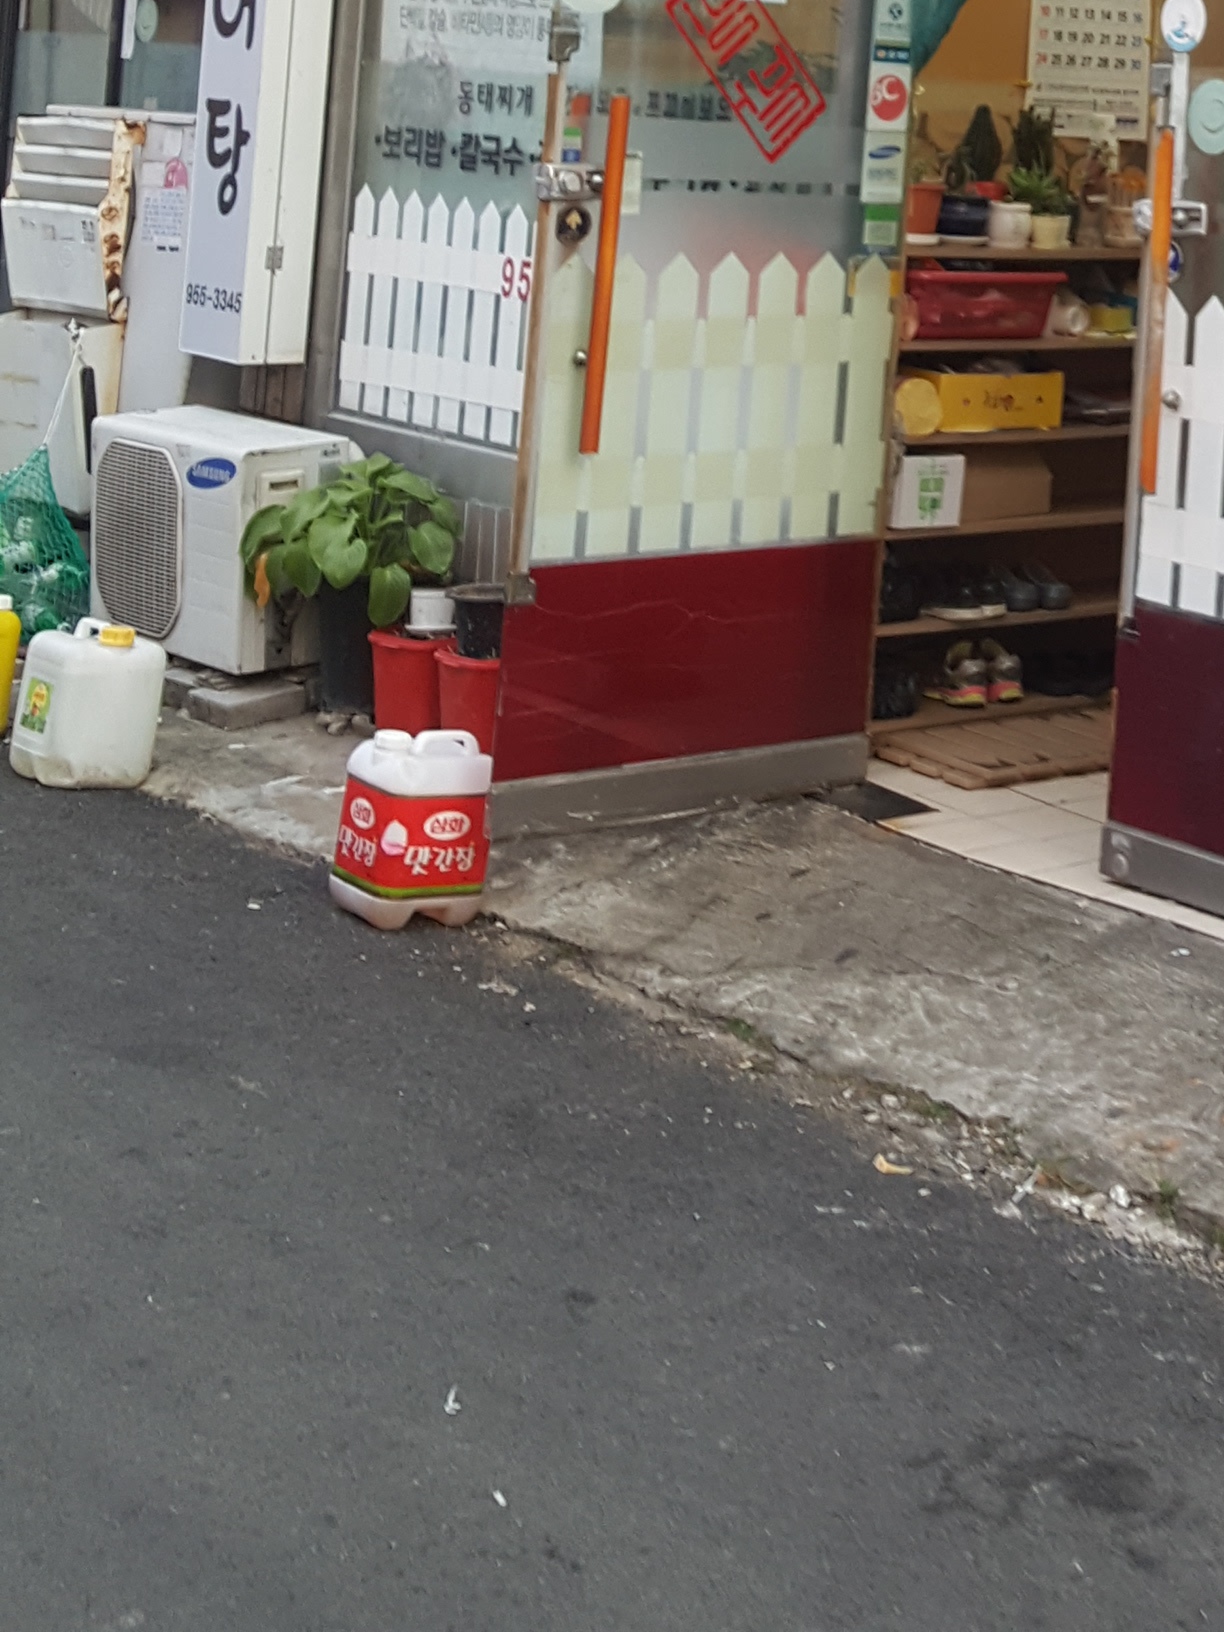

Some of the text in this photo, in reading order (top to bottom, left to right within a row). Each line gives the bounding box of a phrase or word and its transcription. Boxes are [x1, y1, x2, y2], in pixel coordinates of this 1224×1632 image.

[457, 80, 537, 118] 동태찌개
[191, 464, 232, 483] SAMSUNG
[403, 844, 476, 876] 맛간장
